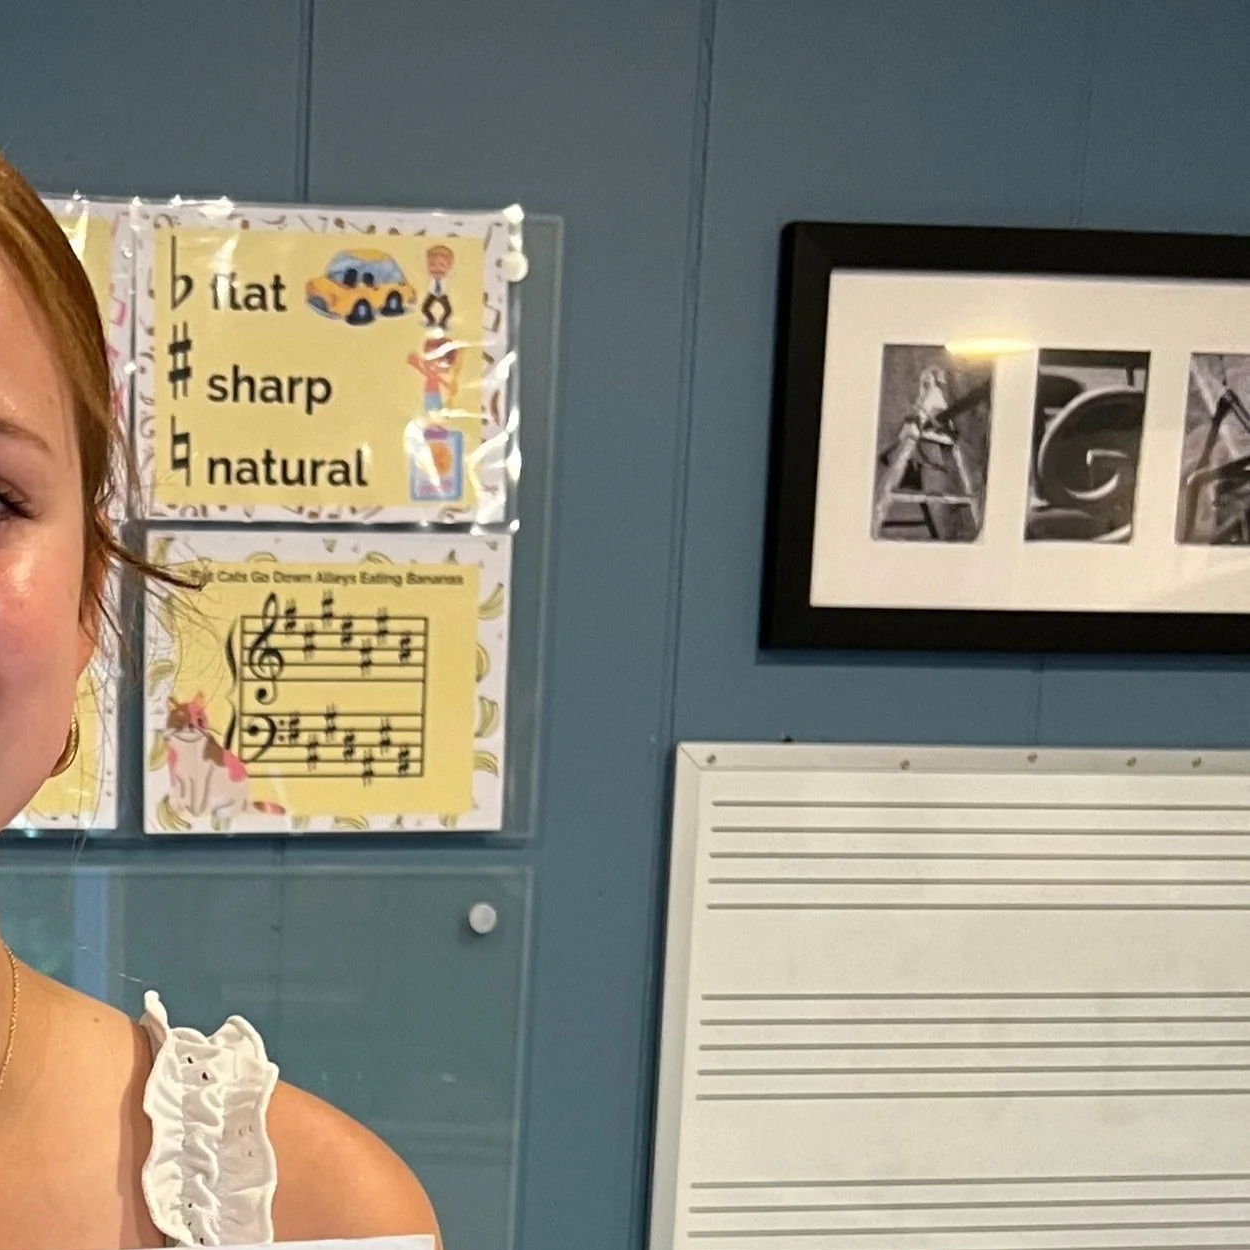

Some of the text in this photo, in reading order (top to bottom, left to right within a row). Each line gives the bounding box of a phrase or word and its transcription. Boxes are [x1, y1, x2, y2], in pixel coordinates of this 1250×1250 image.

[207, 363, 333, 416] sharp
[207, 448, 369, 488] natural
[250, 570, 270, 584] Go
[272, 570, 313, 584] Down
[359, 571, 403, 588] Eating
[406, 572, 464, 586] Bananas
